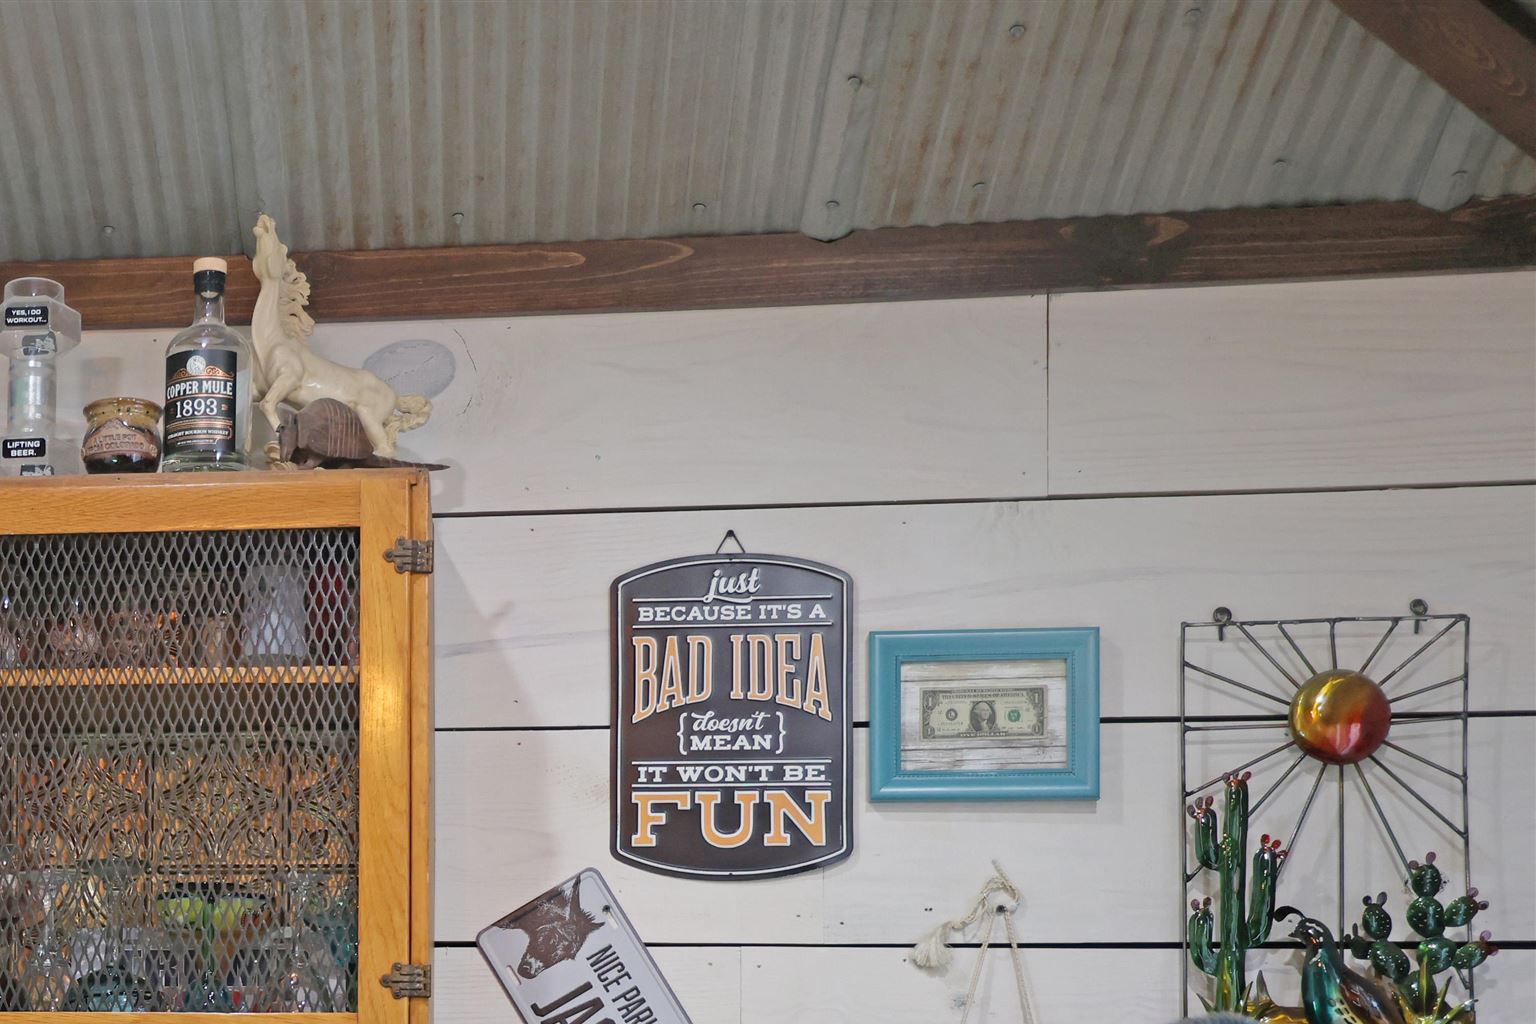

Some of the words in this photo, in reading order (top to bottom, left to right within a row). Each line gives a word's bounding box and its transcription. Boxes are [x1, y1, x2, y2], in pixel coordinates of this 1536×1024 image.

[167, 380, 198, 399] COPPER
[202, 380, 233, 395] MULE
[176, 398, 217, 418] 1893
[703, 568, 762, 604] just
[638, 604, 752, 622] BECAUSE
[758, 603, 802, 620] IT'S
[809, 603, 827, 619] A
[632, 634, 713, 724] BAD
[730, 632, 832, 722] IDEA
[691, 710, 771, 733] doesn't
[690, 734, 773, 751] MEAN
[637, 766, 667, 783] IT
[676, 765, 774, 783] WON'T
[783, 764, 826, 782] BE
[631, 789, 832, 849] FUN
[586, 944, 632, 993] NICE
